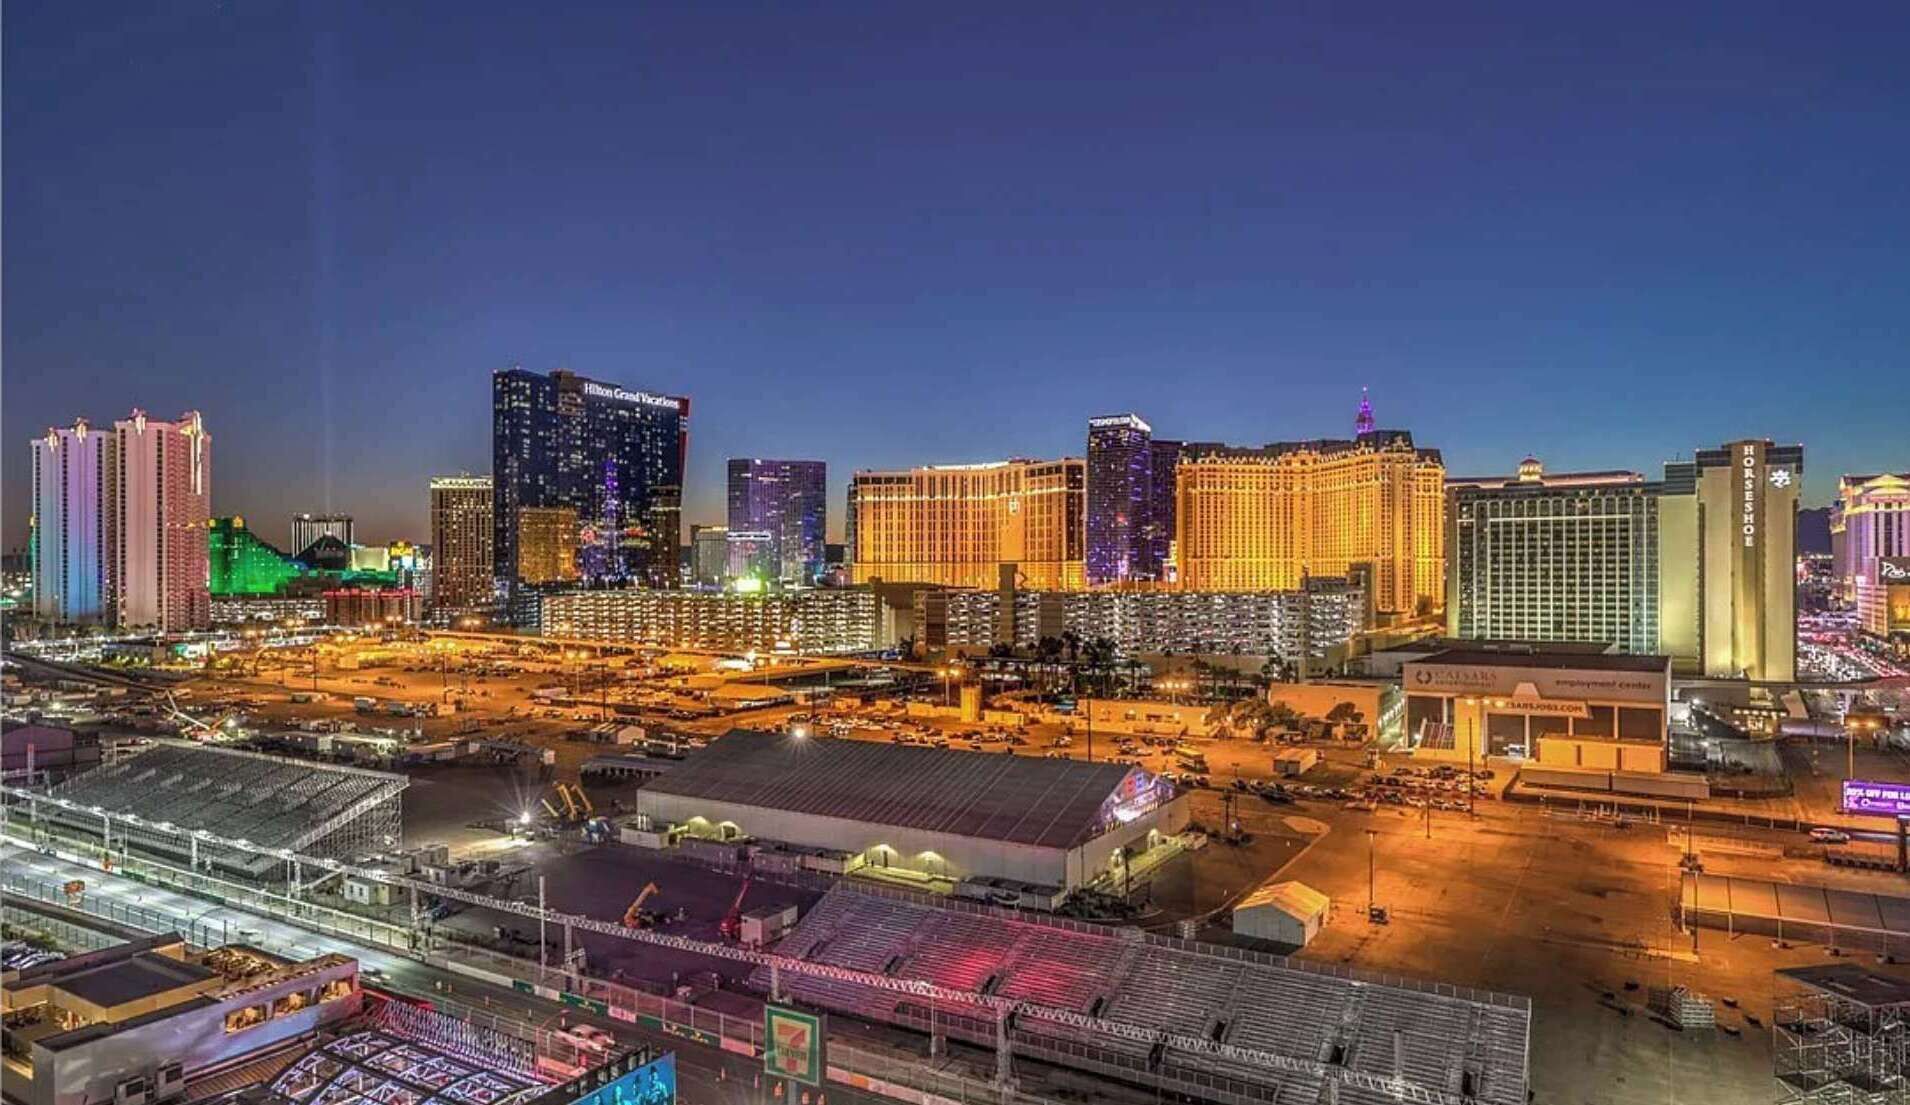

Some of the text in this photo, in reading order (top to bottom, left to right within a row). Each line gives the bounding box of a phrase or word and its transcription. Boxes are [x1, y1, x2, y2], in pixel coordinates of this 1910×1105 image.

[583, 383, 679, 409] Hilton Grand Vacations
[1743, 445, 1756, 547] HORSESHOE
[1555, 679, 1652, 690] employment center
